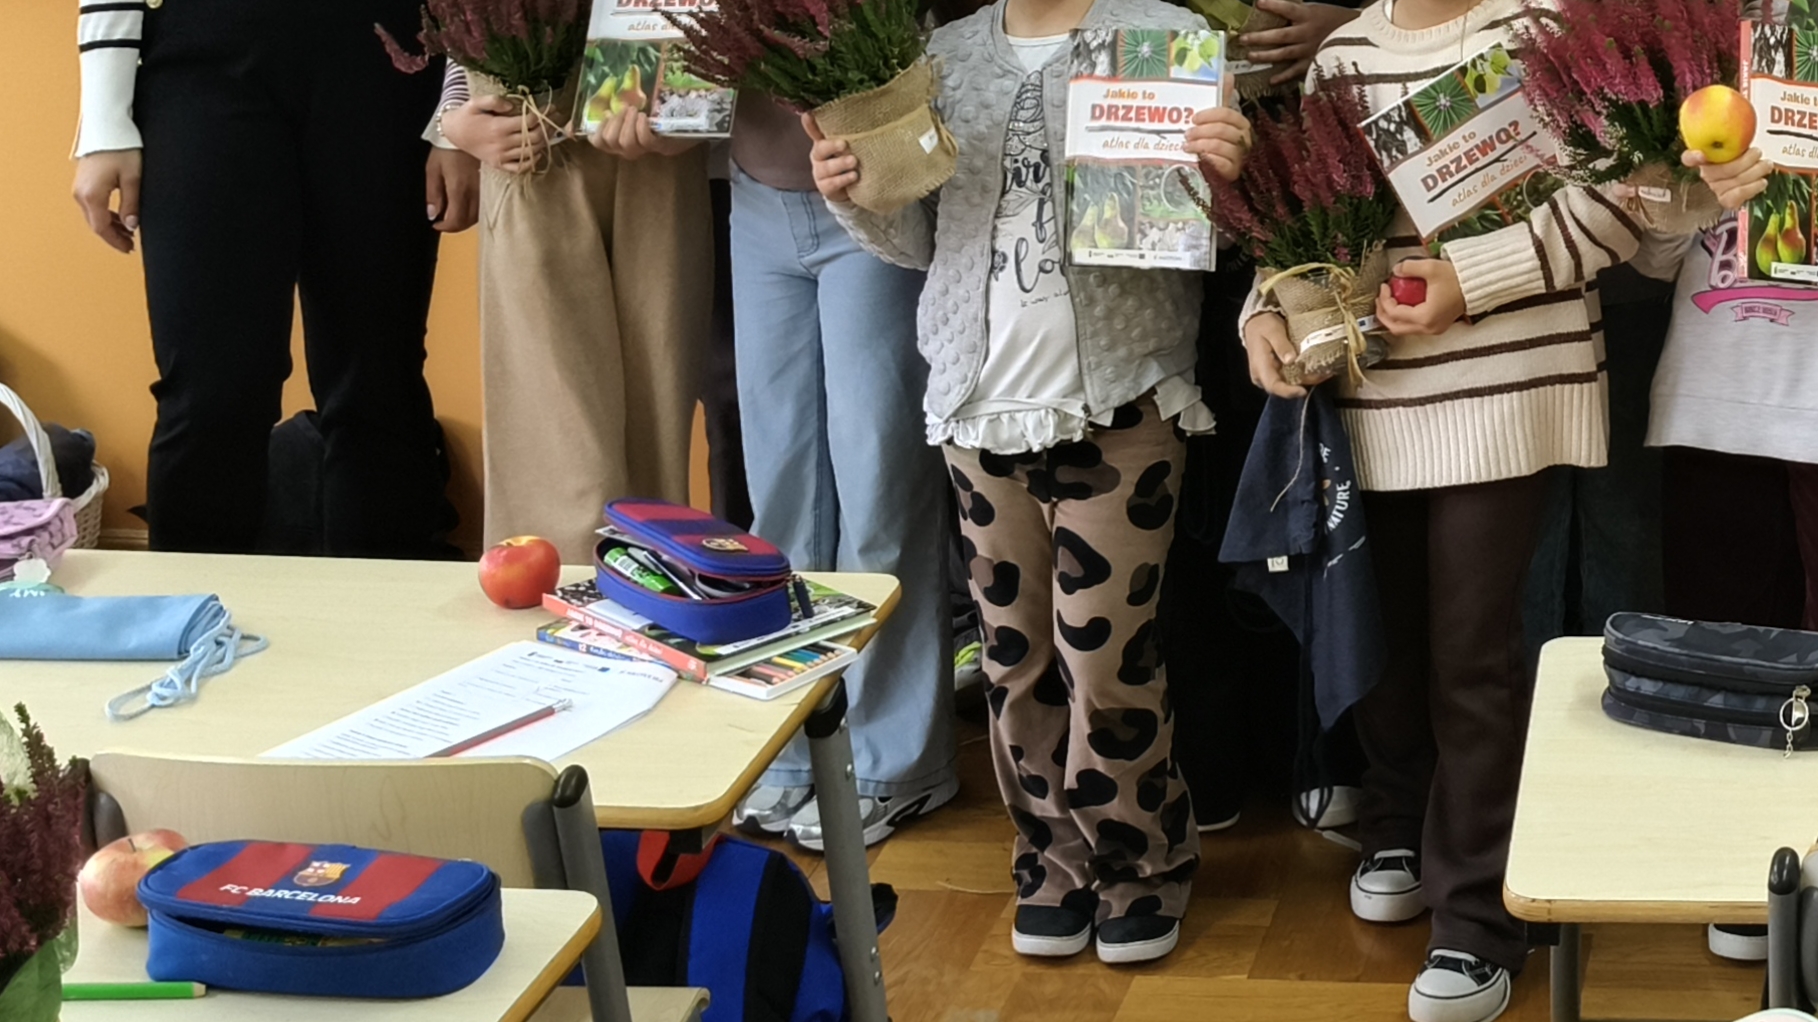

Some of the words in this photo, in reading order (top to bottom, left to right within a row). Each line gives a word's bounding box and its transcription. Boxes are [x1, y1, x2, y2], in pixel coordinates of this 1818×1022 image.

[1103, 88, 1138, 100] Jakie
[1142, 90, 1155, 100] to
[1780, 91, 1811, 106] Jakie
[1090, 103, 1194, 125] DRZEWO?
[1102, 136, 1131, 150] atlas
[1133, 137, 1150, 150] dla
[1426, 143, 1461, 168] Jakie
[1462, 131, 1477, 144] to
[1782, 144, 1807, 158] atlas
[1420, 119, 1523, 193] DRZEWO?
[1452, 184, 1479, 207] atlas
[1481, 173, 1498, 189] dla
[1500, 155, 1528, 176] dzieci
[219, 883, 248, 894] FC
[245, 888, 361, 904] BARCELONA
